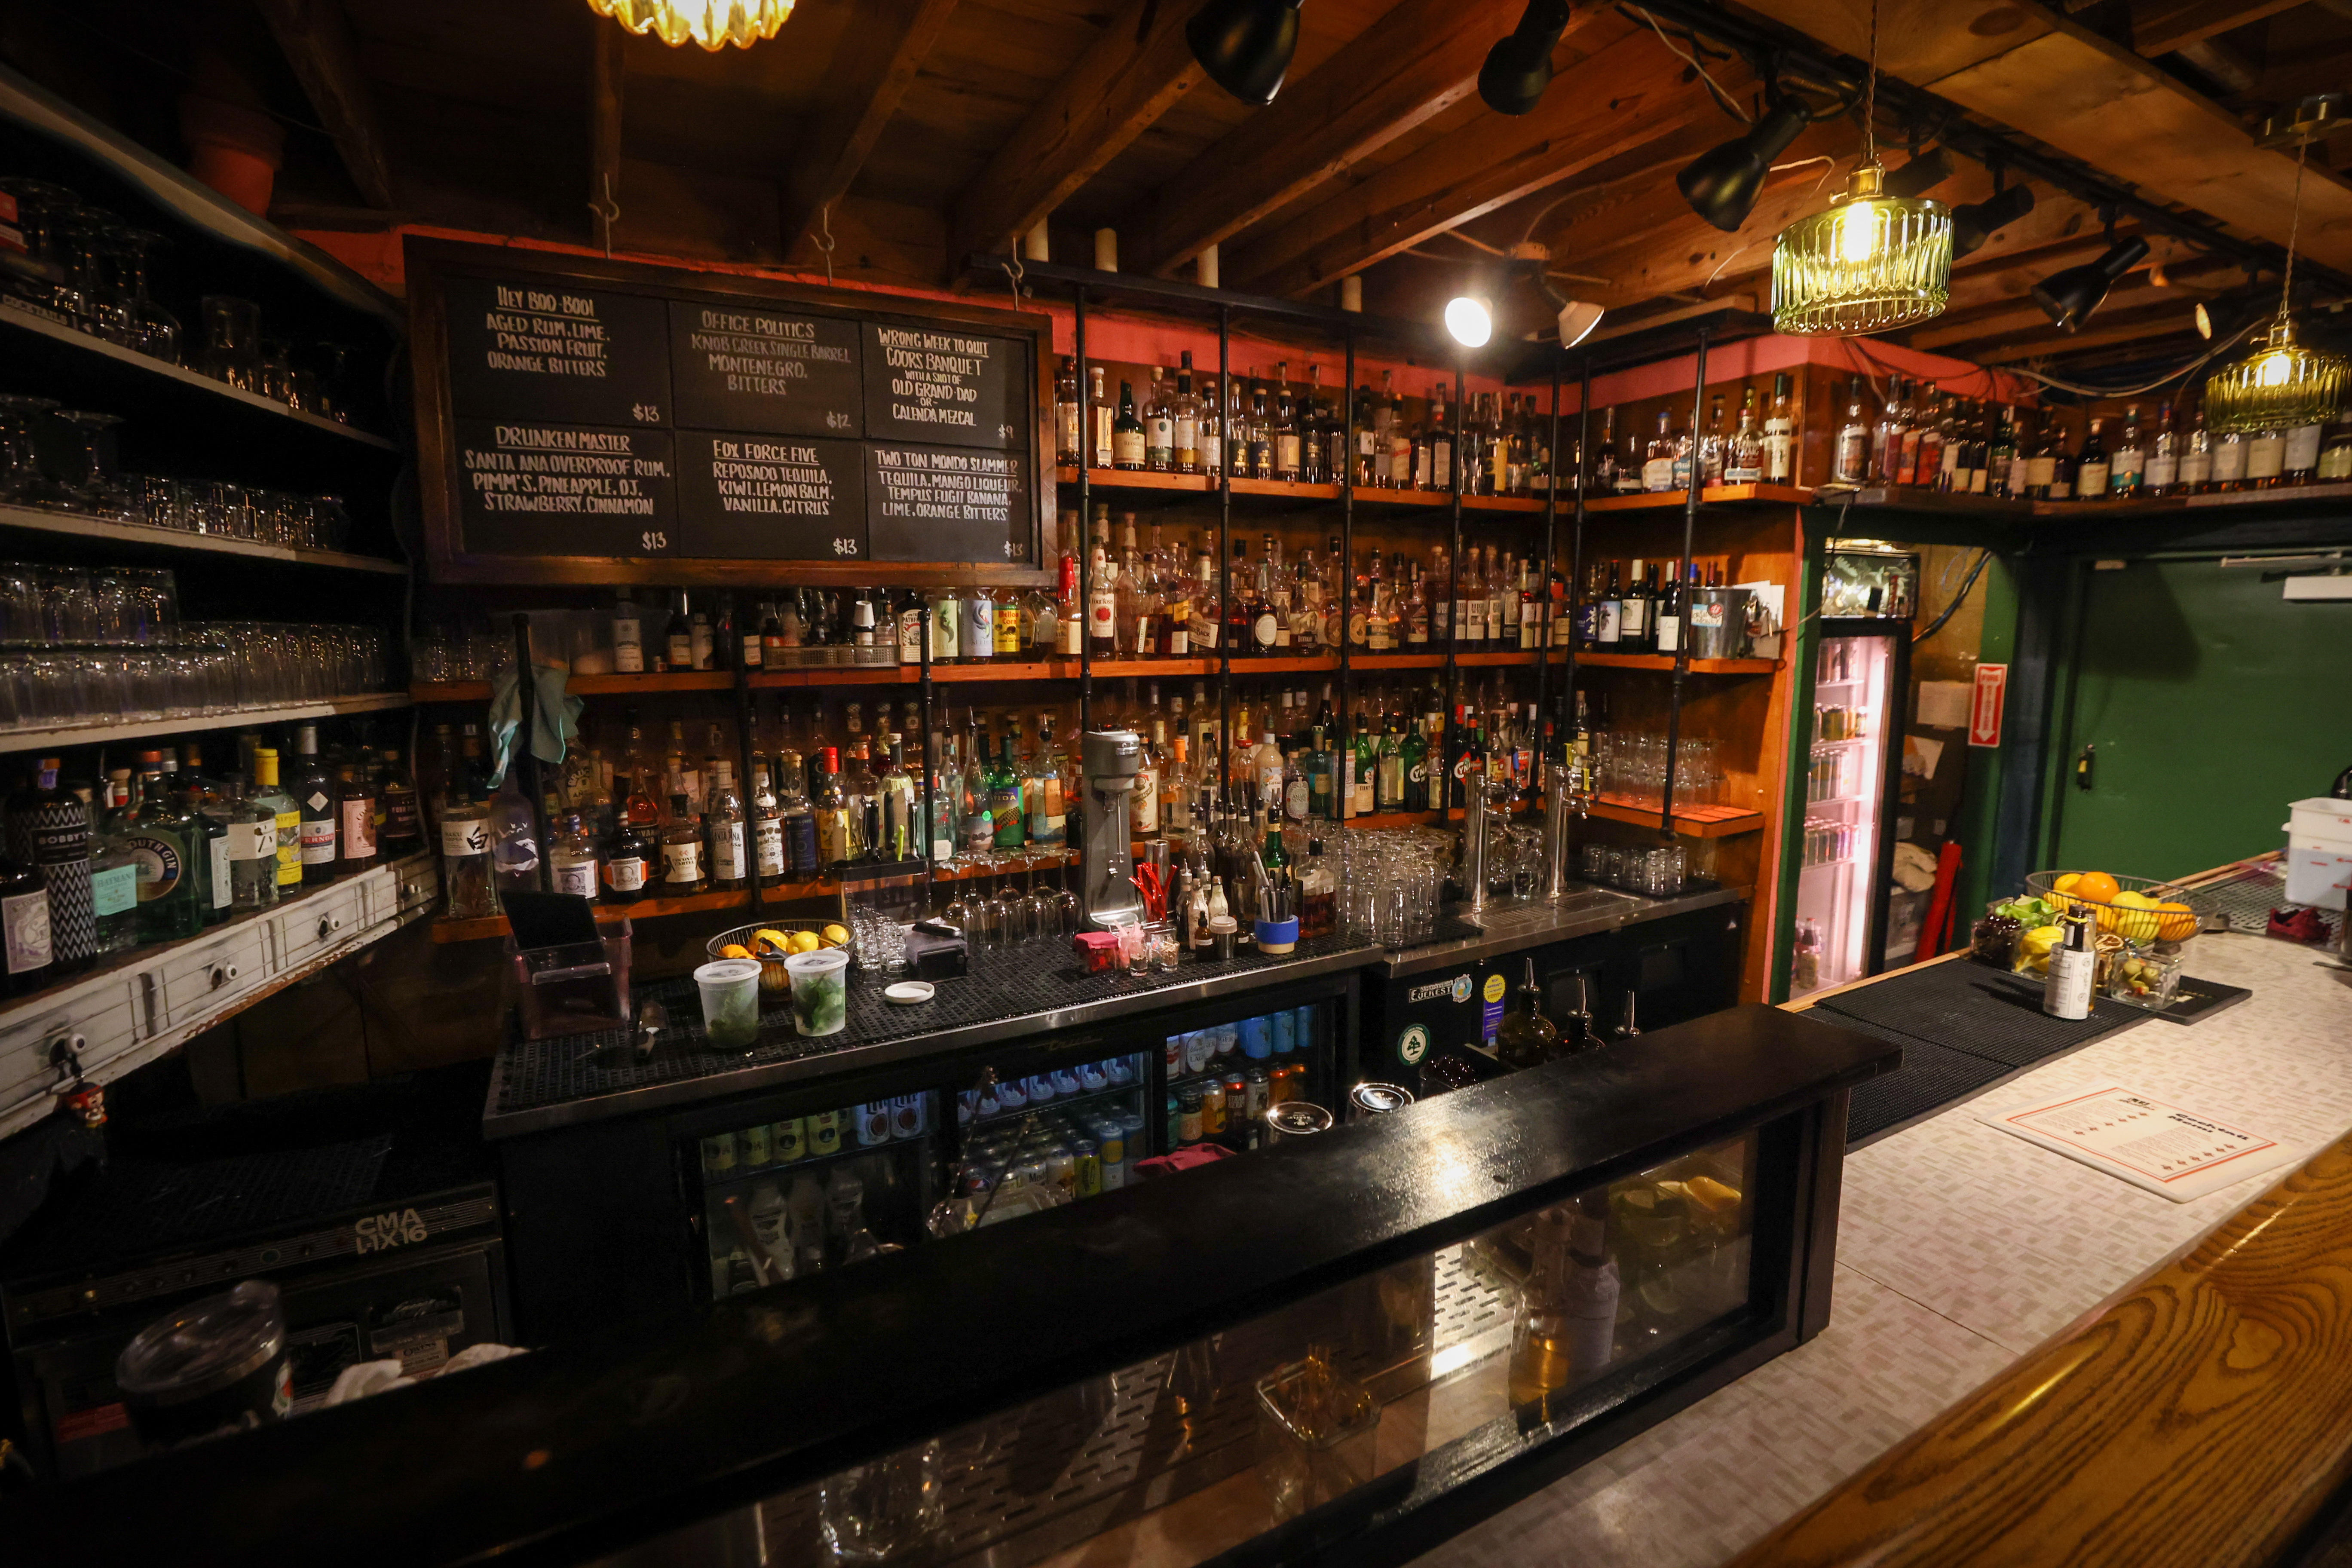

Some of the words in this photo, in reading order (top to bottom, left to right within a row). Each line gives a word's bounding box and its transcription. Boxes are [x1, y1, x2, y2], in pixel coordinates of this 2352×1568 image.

[497, 285, 523, 308] HEY
[487, 313, 528, 333] AGED
[702, 310, 750, 332] OFFICE
[756, 318, 815, 339] POLITICS
[497, 332, 563, 355] PASSION
[692, 334, 730, 351] KNOB
[732, 337, 769, 355] CREEK
[770, 341, 809, 358] SINGLE
[878, 328, 921, 348] WRONG
[924, 334, 950, 351] WEEK
[953, 338, 965, 352] TO
[967, 341, 988, 355] QUIT
[487, 351, 546, 373] ORANGE
[548, 358, 606, 377] BITTERS
[886, 347, 923, 369] COORS
[926, 353, 983, 376] BANQUET
[728, 374, 786, 395] BITTERS
[892, 379, 913, 396] OLD
[905, 370, 924, 381] WITH
[926, 372, 931, 382] A
[933, 374, 951, 383] SHOT
[952, 375, 962, 385] OF
[632, 403, 659, 422] $13
[827, 411, 851, 428] $12
[893, 403, 937, 422] CALENDA
[939, 409, 977, 426] MEZCAL
[496, 426, 576, 448] DRUNKEN
[579, 432, 630, 451] MASTER
[998, 424, 1014, 438] $9
[713, 439, 739, 458] FOX
[744, 443, 788, 461] FORCE
[790, 447, 819, 463] FIVE
[465, 449, 515, 470] SANTA
[519, 454, 549, 472] ANA
[550, 455, 630, 475] OVERPROOF
[713, 461, 778, 481] REPOSADO
[875, 450, 901, 466] TWO
[903, 452, 928, 468] TON
[931, 454, 968, 471] MONDO
[970, 457, 1018, 473] SLAMMER
[756, 482, 797, 498] LEMON
[931, 474, 971, 490] MANGO
[887, 486, 932, 502] TEMPUS
[934, 489, 965, 503] FUGIT
[586, 496, 653, 515] CINNAMON
[782, 499, 829, 515] CITRUS
[916, 503, 961, 519] ORANGE
[963, 505, 1008, 521] BITTERS
[642, 531, 667, 550] $13
[833, 538, 857, 555] $13
[1004, 540, 1023, 557] $13
[162, 850, 178, 869] GIN
[355, 1208, 423, 1235] CMA
